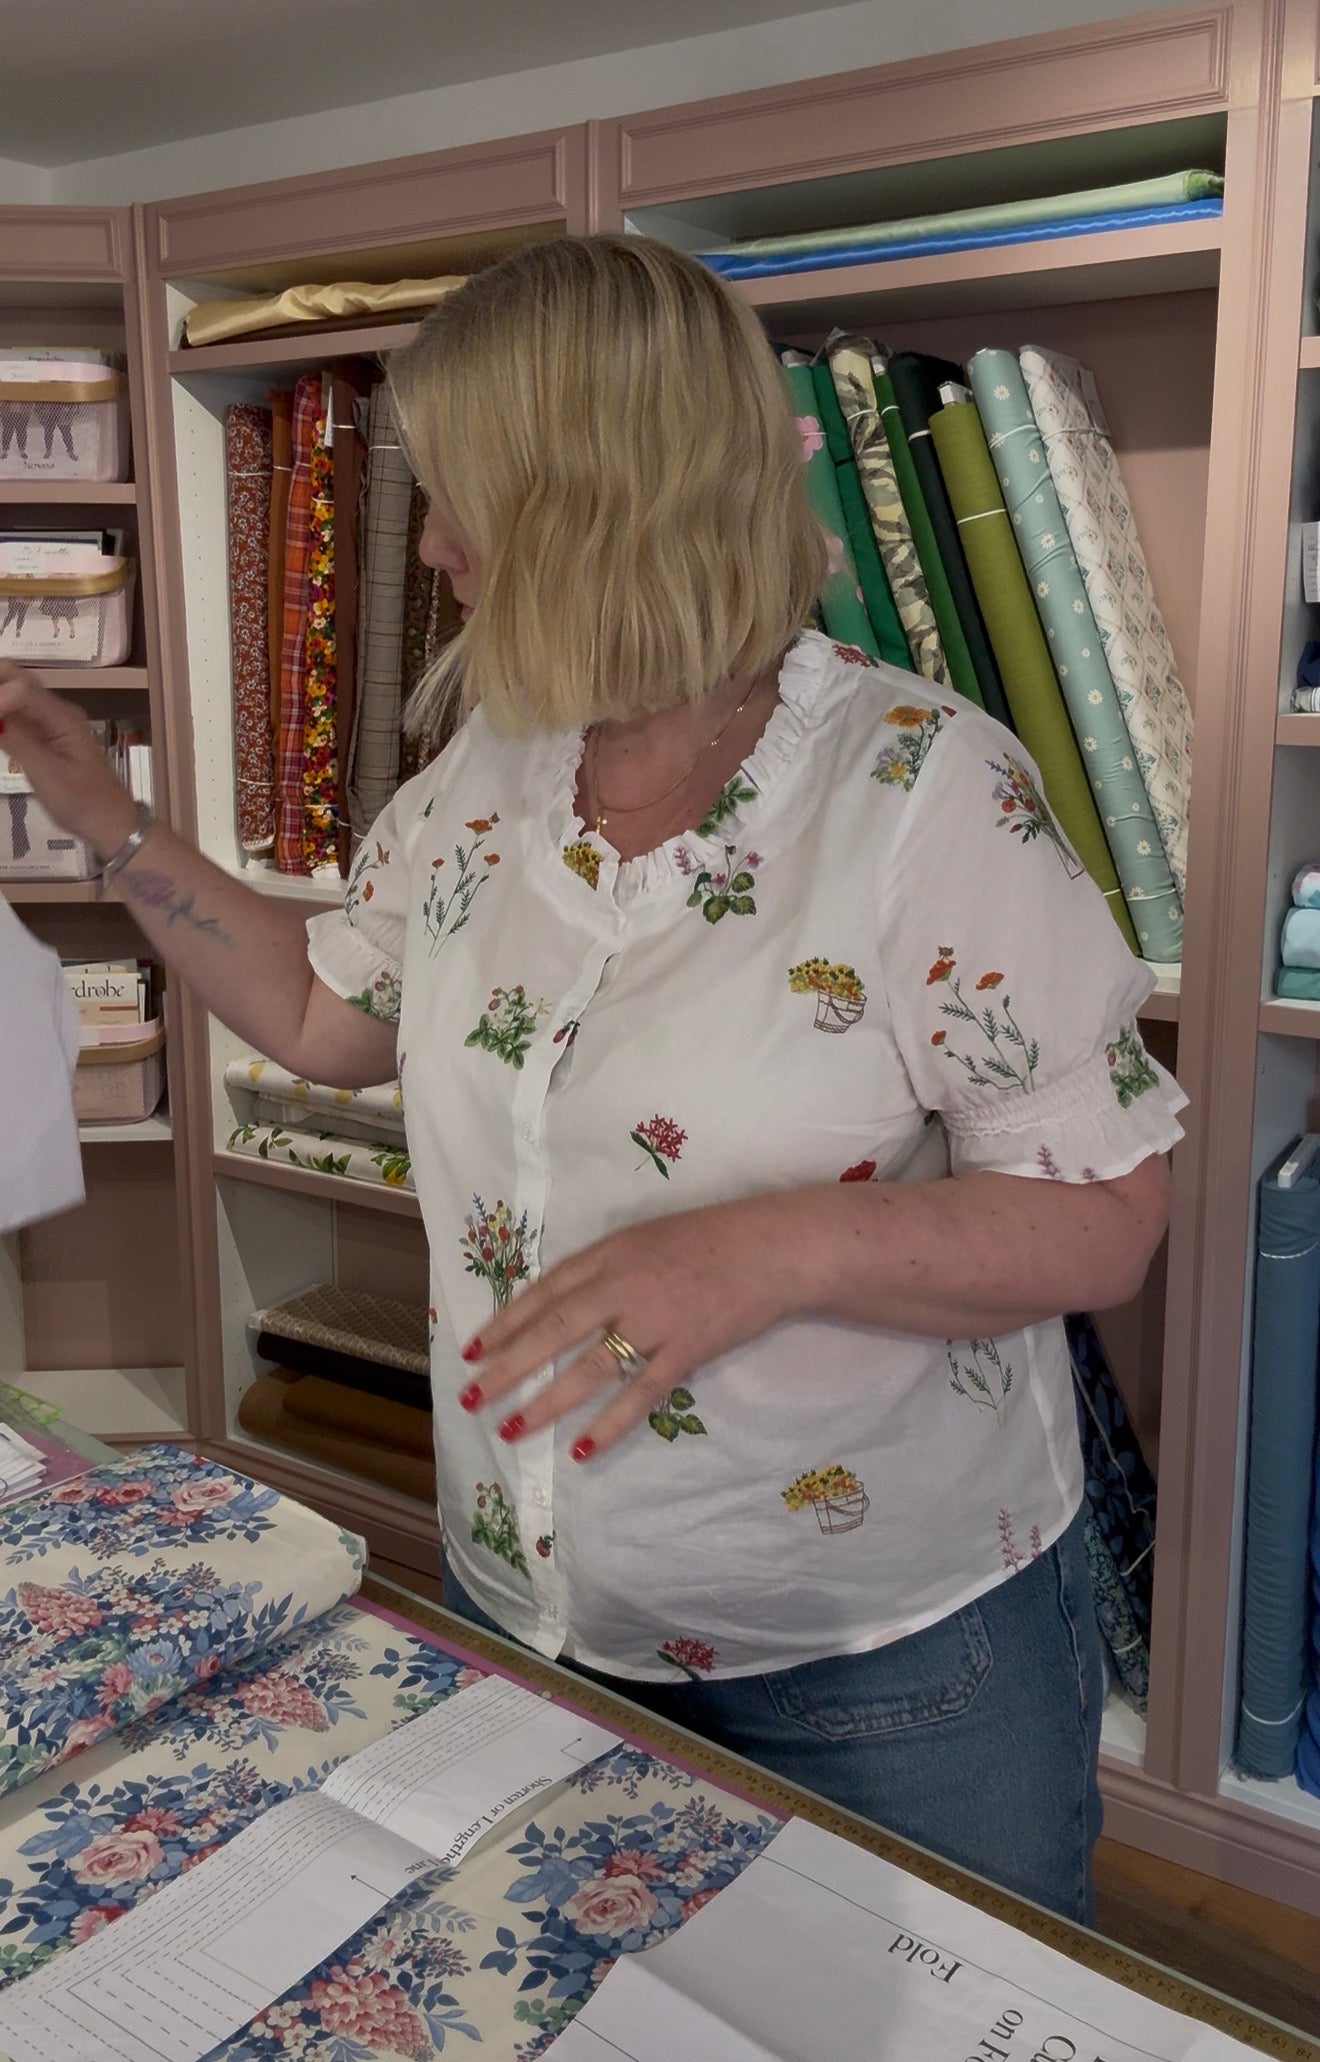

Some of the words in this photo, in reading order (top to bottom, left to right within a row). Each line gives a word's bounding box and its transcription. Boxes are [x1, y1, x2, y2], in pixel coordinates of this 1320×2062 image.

[503, 1775, 552, 1806] Shorten
[492, 1804, 505, 1818] or
[441, 1815, 494, 1866] Lengthe
[886, 1933, 965, 1985] Fold
[990, 2008, 1025, 2041] on
[1248, 2024, 1268, 2039] 20
